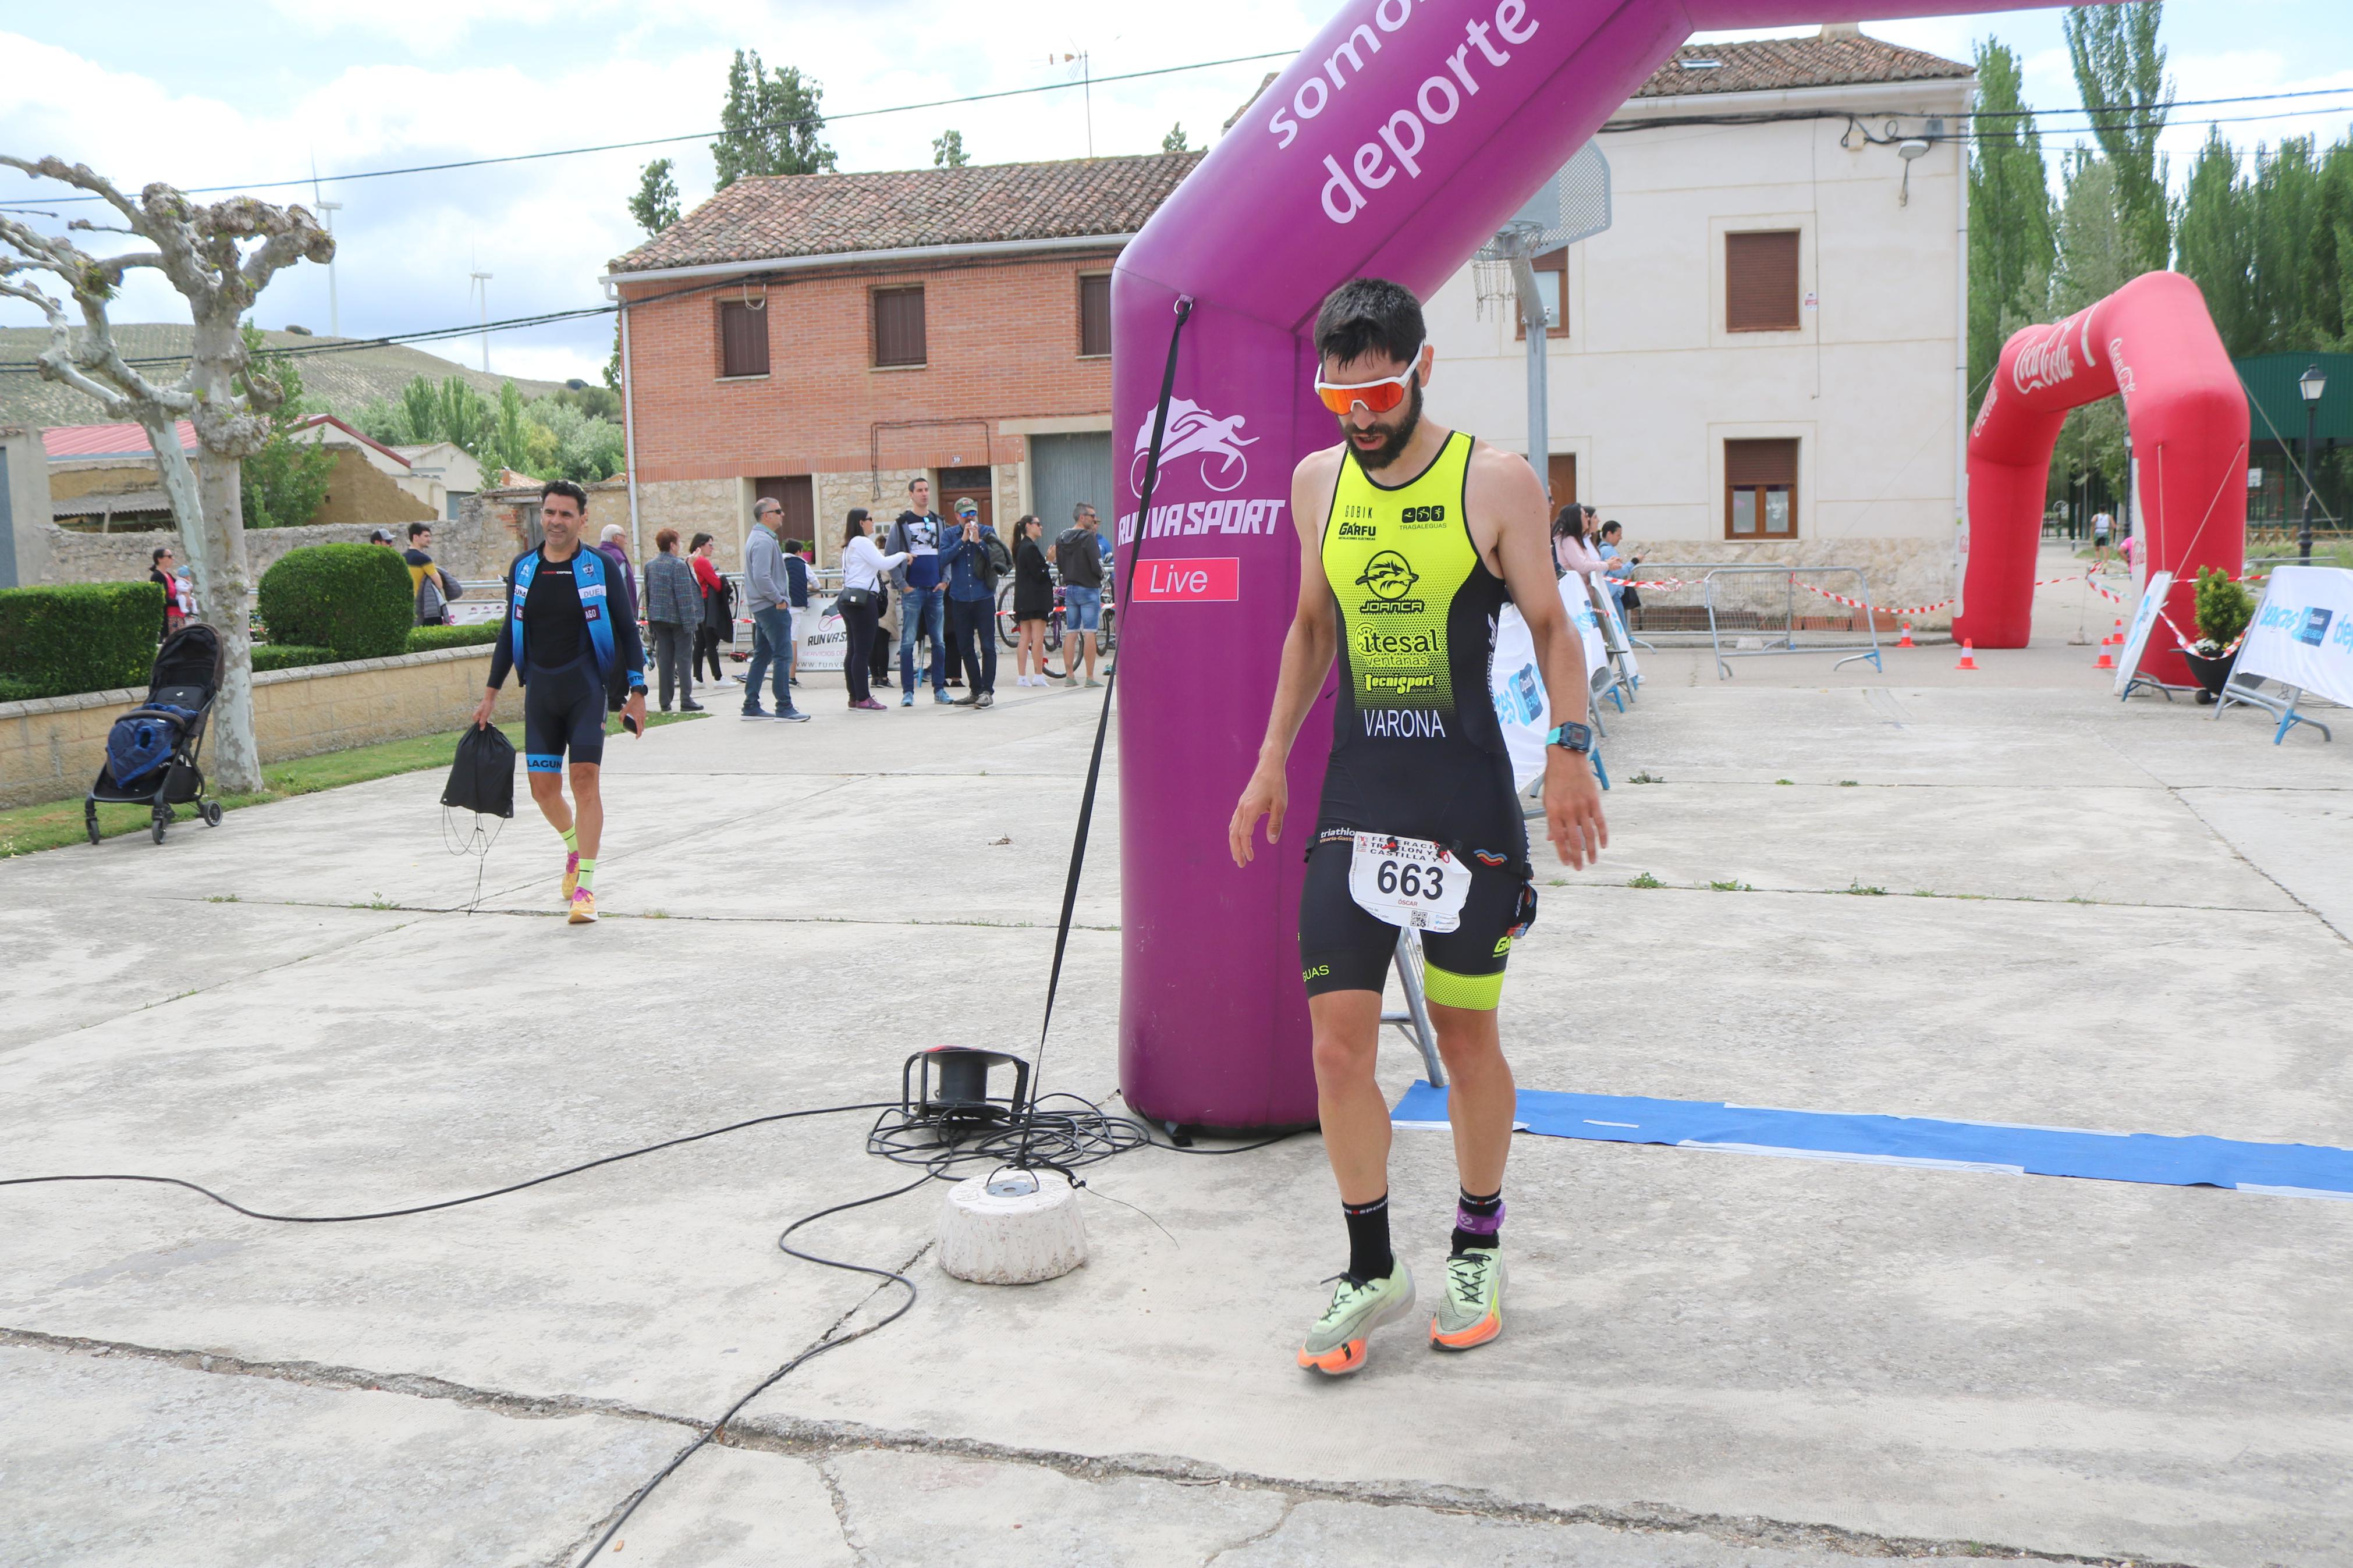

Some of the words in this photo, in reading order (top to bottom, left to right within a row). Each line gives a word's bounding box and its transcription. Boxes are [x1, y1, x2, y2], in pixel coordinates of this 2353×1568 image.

[1269, 0, 1425, 150] somo
[1321, 0, 1540, 224] deporte
[1345, 505, 1372, 519] GOBIK
[1149, 564, 1208, 593] Live
[1366, 656, 1427, 666] ventanas
[1364, 709, 1446, 738] VARONA
[1371, 849, 1426, 861] CASTILLA
[1378, 860, 1443, 900] 663
[1398, 898, 1418, 906] ÓSCAR
